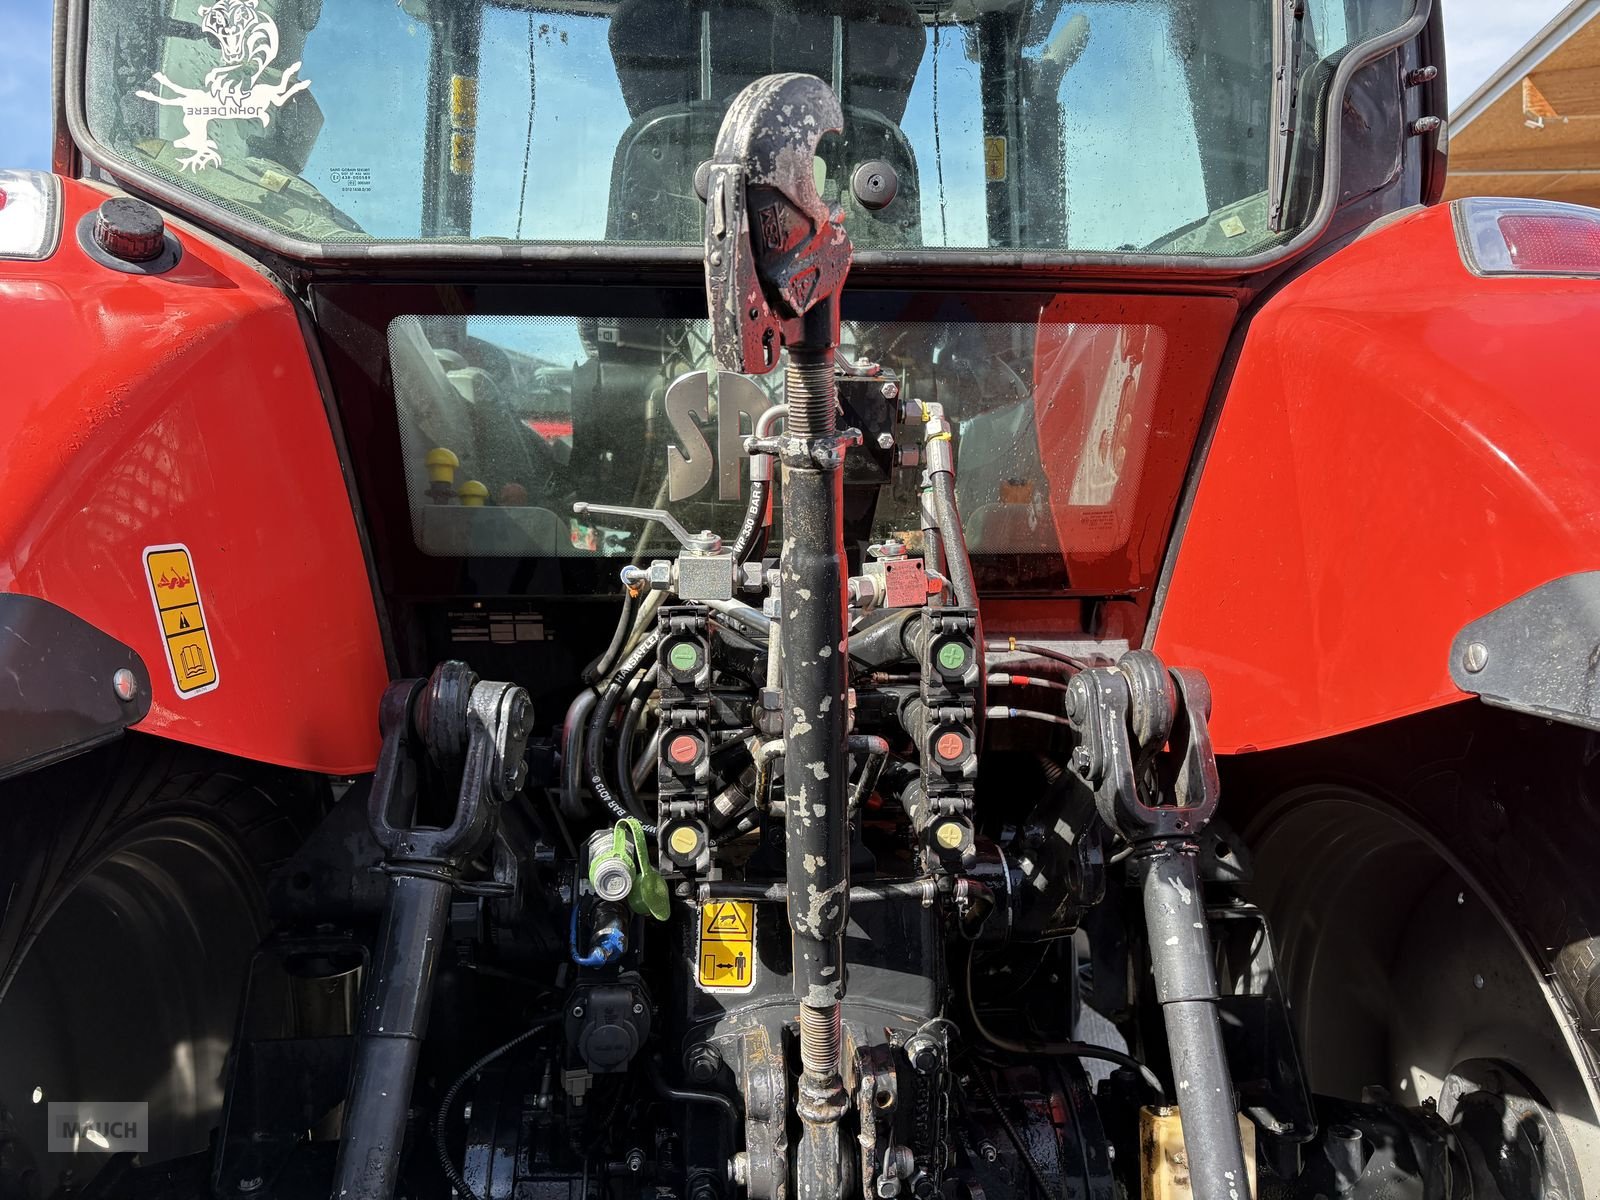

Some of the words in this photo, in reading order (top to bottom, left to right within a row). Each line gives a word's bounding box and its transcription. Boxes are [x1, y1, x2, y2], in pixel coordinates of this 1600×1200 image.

[187, 106, 227, 117] DEERE
[229, 106, 263, 116] JOHN
[733, 536, 746, 553] WP
[742, 518, 755, 538] 330
[749, 490, 762, 515] BAR
[607, 800, 626, 817] BAR
